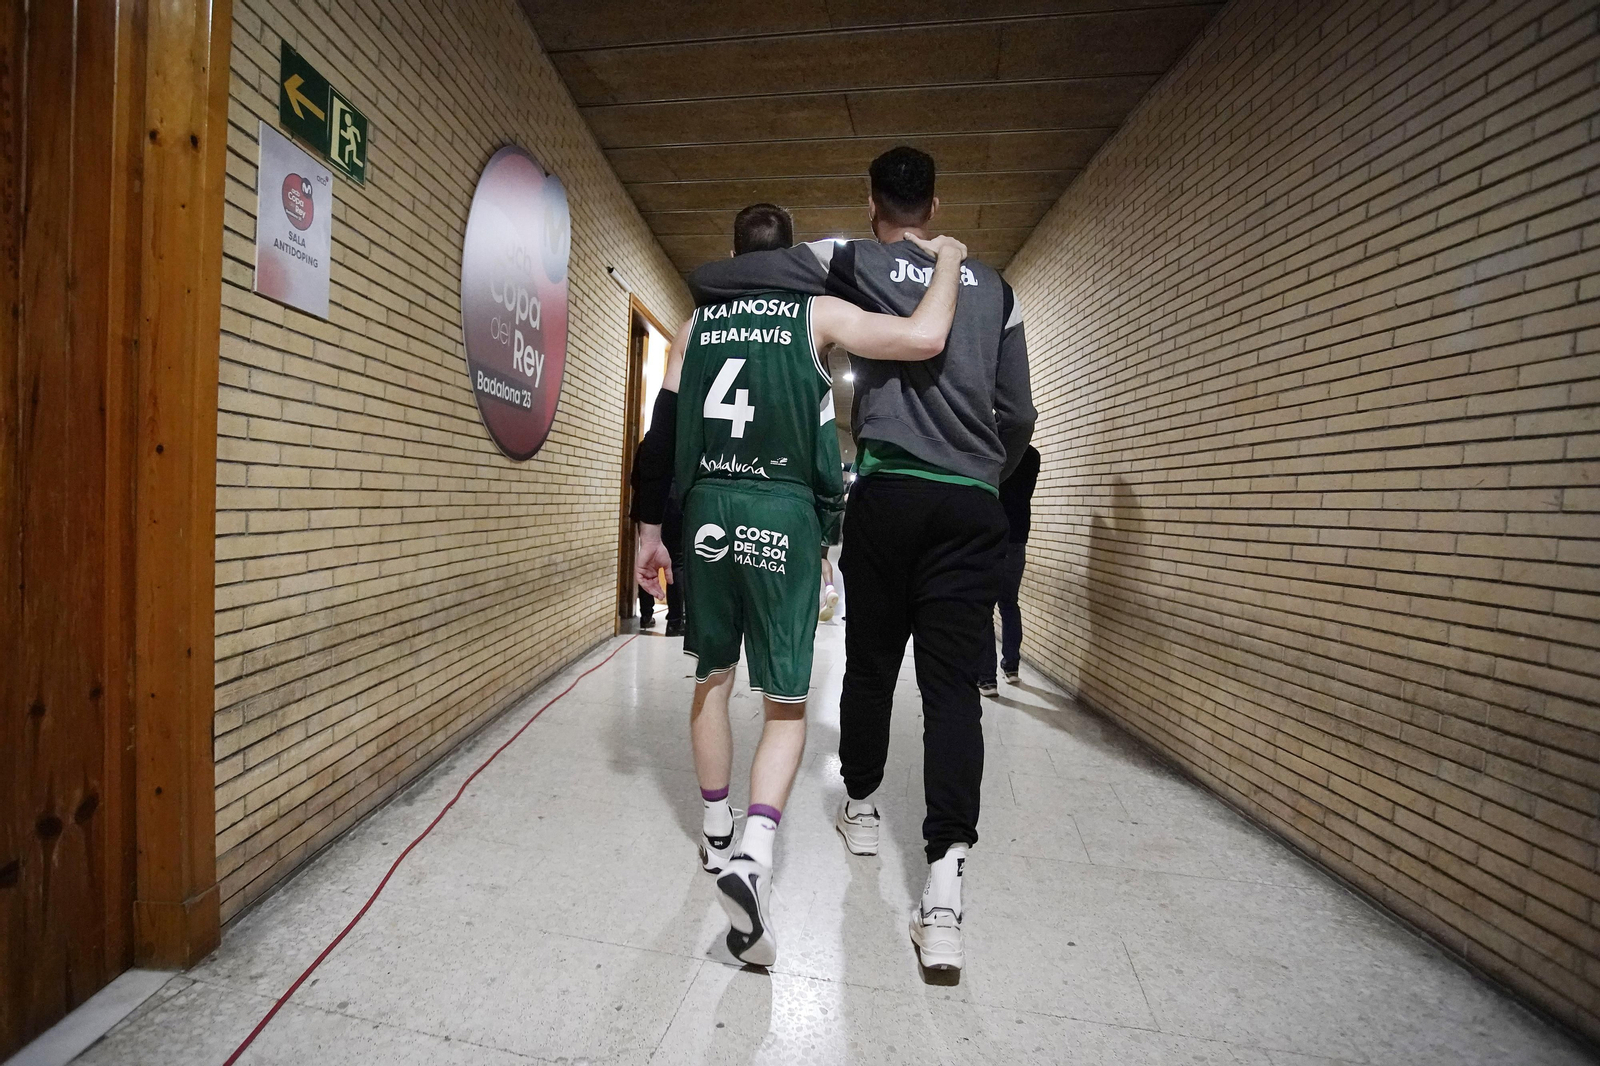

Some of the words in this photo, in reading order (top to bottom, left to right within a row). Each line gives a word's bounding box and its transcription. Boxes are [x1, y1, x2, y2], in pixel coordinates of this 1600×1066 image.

[287, 191, 304, 208] Copa
[295, 205, 306, 219] Rey
[288, 230, 306, 249] SALA
[273, 238, 319, 269] ANTIDOPING
[490, 263, 541, 331] Copa
[703, 299, 800, 322] KAINOSKI
[490, 315, 511, 347] del
[513, 329, 545, 389] Rey
[476, 370, 521, 405] Badalona
[703, 357, 756, 438] 4
[699, 453, 771, 480] Andalucía
[735, 525, 789, 549] COSTA
[733, 540, 760, 556] DEL
[761, 545, 787, 563] SOL
[734, 553, 786, 575] MÁLAGA
